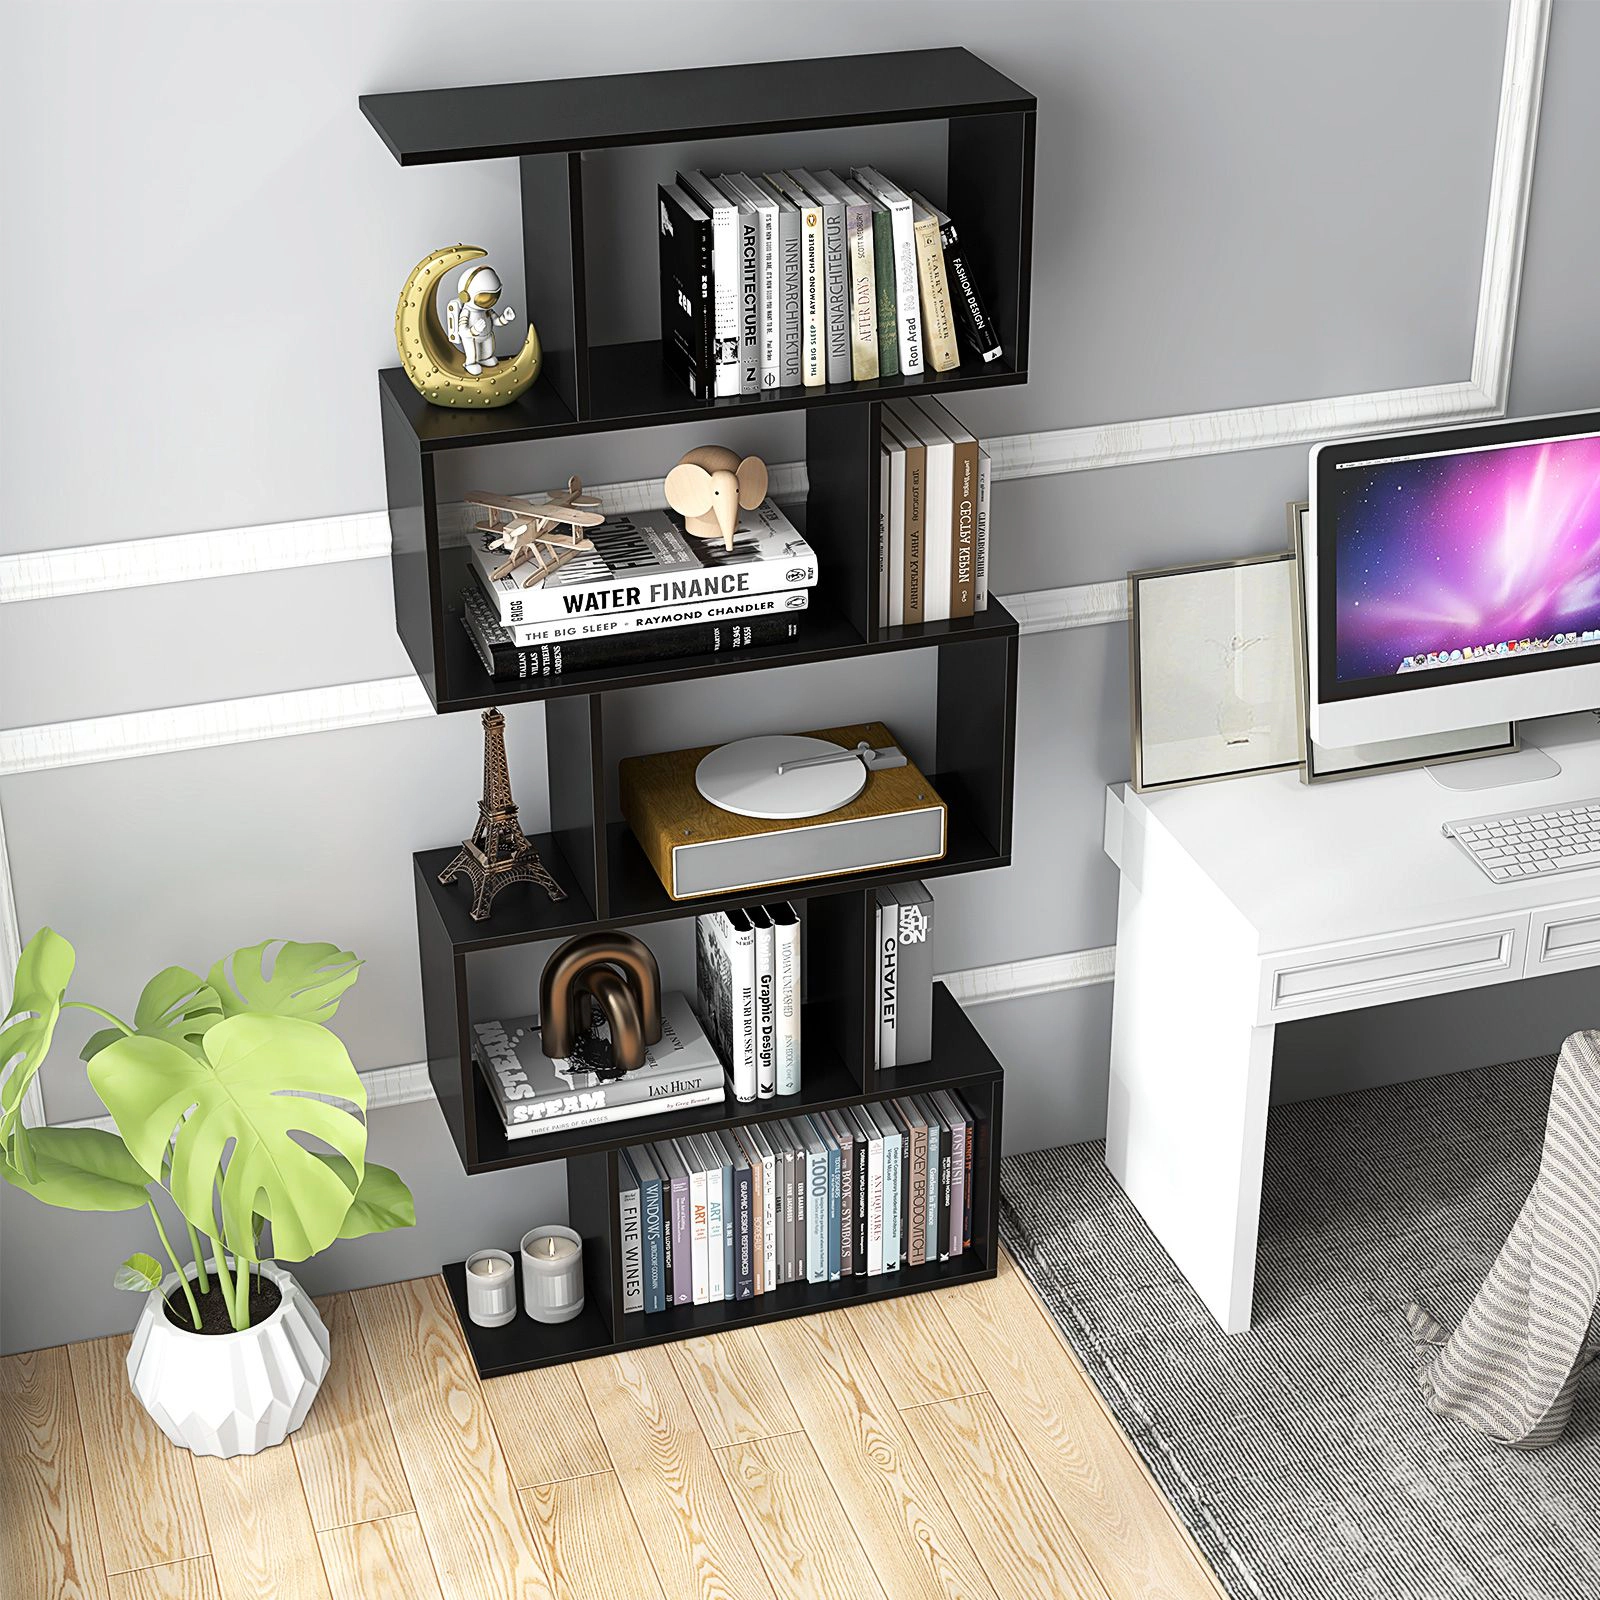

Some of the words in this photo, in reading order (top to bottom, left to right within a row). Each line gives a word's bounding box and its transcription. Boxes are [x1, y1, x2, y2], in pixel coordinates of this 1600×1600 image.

[743, 225, 757, 347] ARCHITECTURE
[827, 215, 846, 358] INNENARCHITEKTUR
[856, 276, 870, 305] DAYS
[932, 254, 943, 295] HARRY
[938, 300, 950, 339] POTTER
[952, 257, 974, 297] FASHION
[967, 296, 986, 330] DESIGN
[785, 238, 799, 376] INNENARCHITEKTUR
[858, 308, 872, 342] AFTER
[906, 318, 917, 342] Arad
[908, 345, 918, 368] Ron
[510, 600, 523, 622] GRIGG
[563, 586, 641, 614] WATER
[650, 572, 749, 602] FINANCE
[525, 630, 549, 640] THE
[554, 627, 576, 637] BIG
[582, 622, 618, 634] SLEEP
[636, 611, 702, 626] RAYMOND
[708, 601, 774, 617] CHANDLER
[760, 934, 771, 973] Swiss
[782, 942, 792, 974] WOMAN
[742, 988, 752, 1016] HENRI
[758, 974, 772, 1022] Graphic
[782, 975, 794, 1018] UNLEASHED
[473, 1020, 536, 1101] STEAM
[744, 1018, 752, 1067] ROUSSEAU
[760, 1025, 773, 1068] Design
[648, 1084, 668, 1096] IAN
[670, 1078, 702, 1092] HUNT
[513, 1090, 606, 1124] STEAM
[914, 1130, 926, 1176] ALEXEY
[952, 1128, 964, 1156] LOST
[812, 1158, 826, 1197] 1000
[842, 1170, 852, 1200] BOOK
[952, 1160, 962, 1186] FISH
[646, 1184, 660, 1240] WINDOWS
[695, 1204, 706, 1224] ART
[710, 1202, 721, 1222] ART
[740, 1181, 748, 1210] GRAPHIC
[873, 1175, 882, 1240] ANTIQUAIRES
[928, 1200, 936, 1226] France
[624, 1207, 638, 1242] FINE
[842, 1208, 851, 1258] SYMBOLS
[912, 1180, 926, 1258] BRODOVITCH
[626, 1246, 640, 1296] WINES
